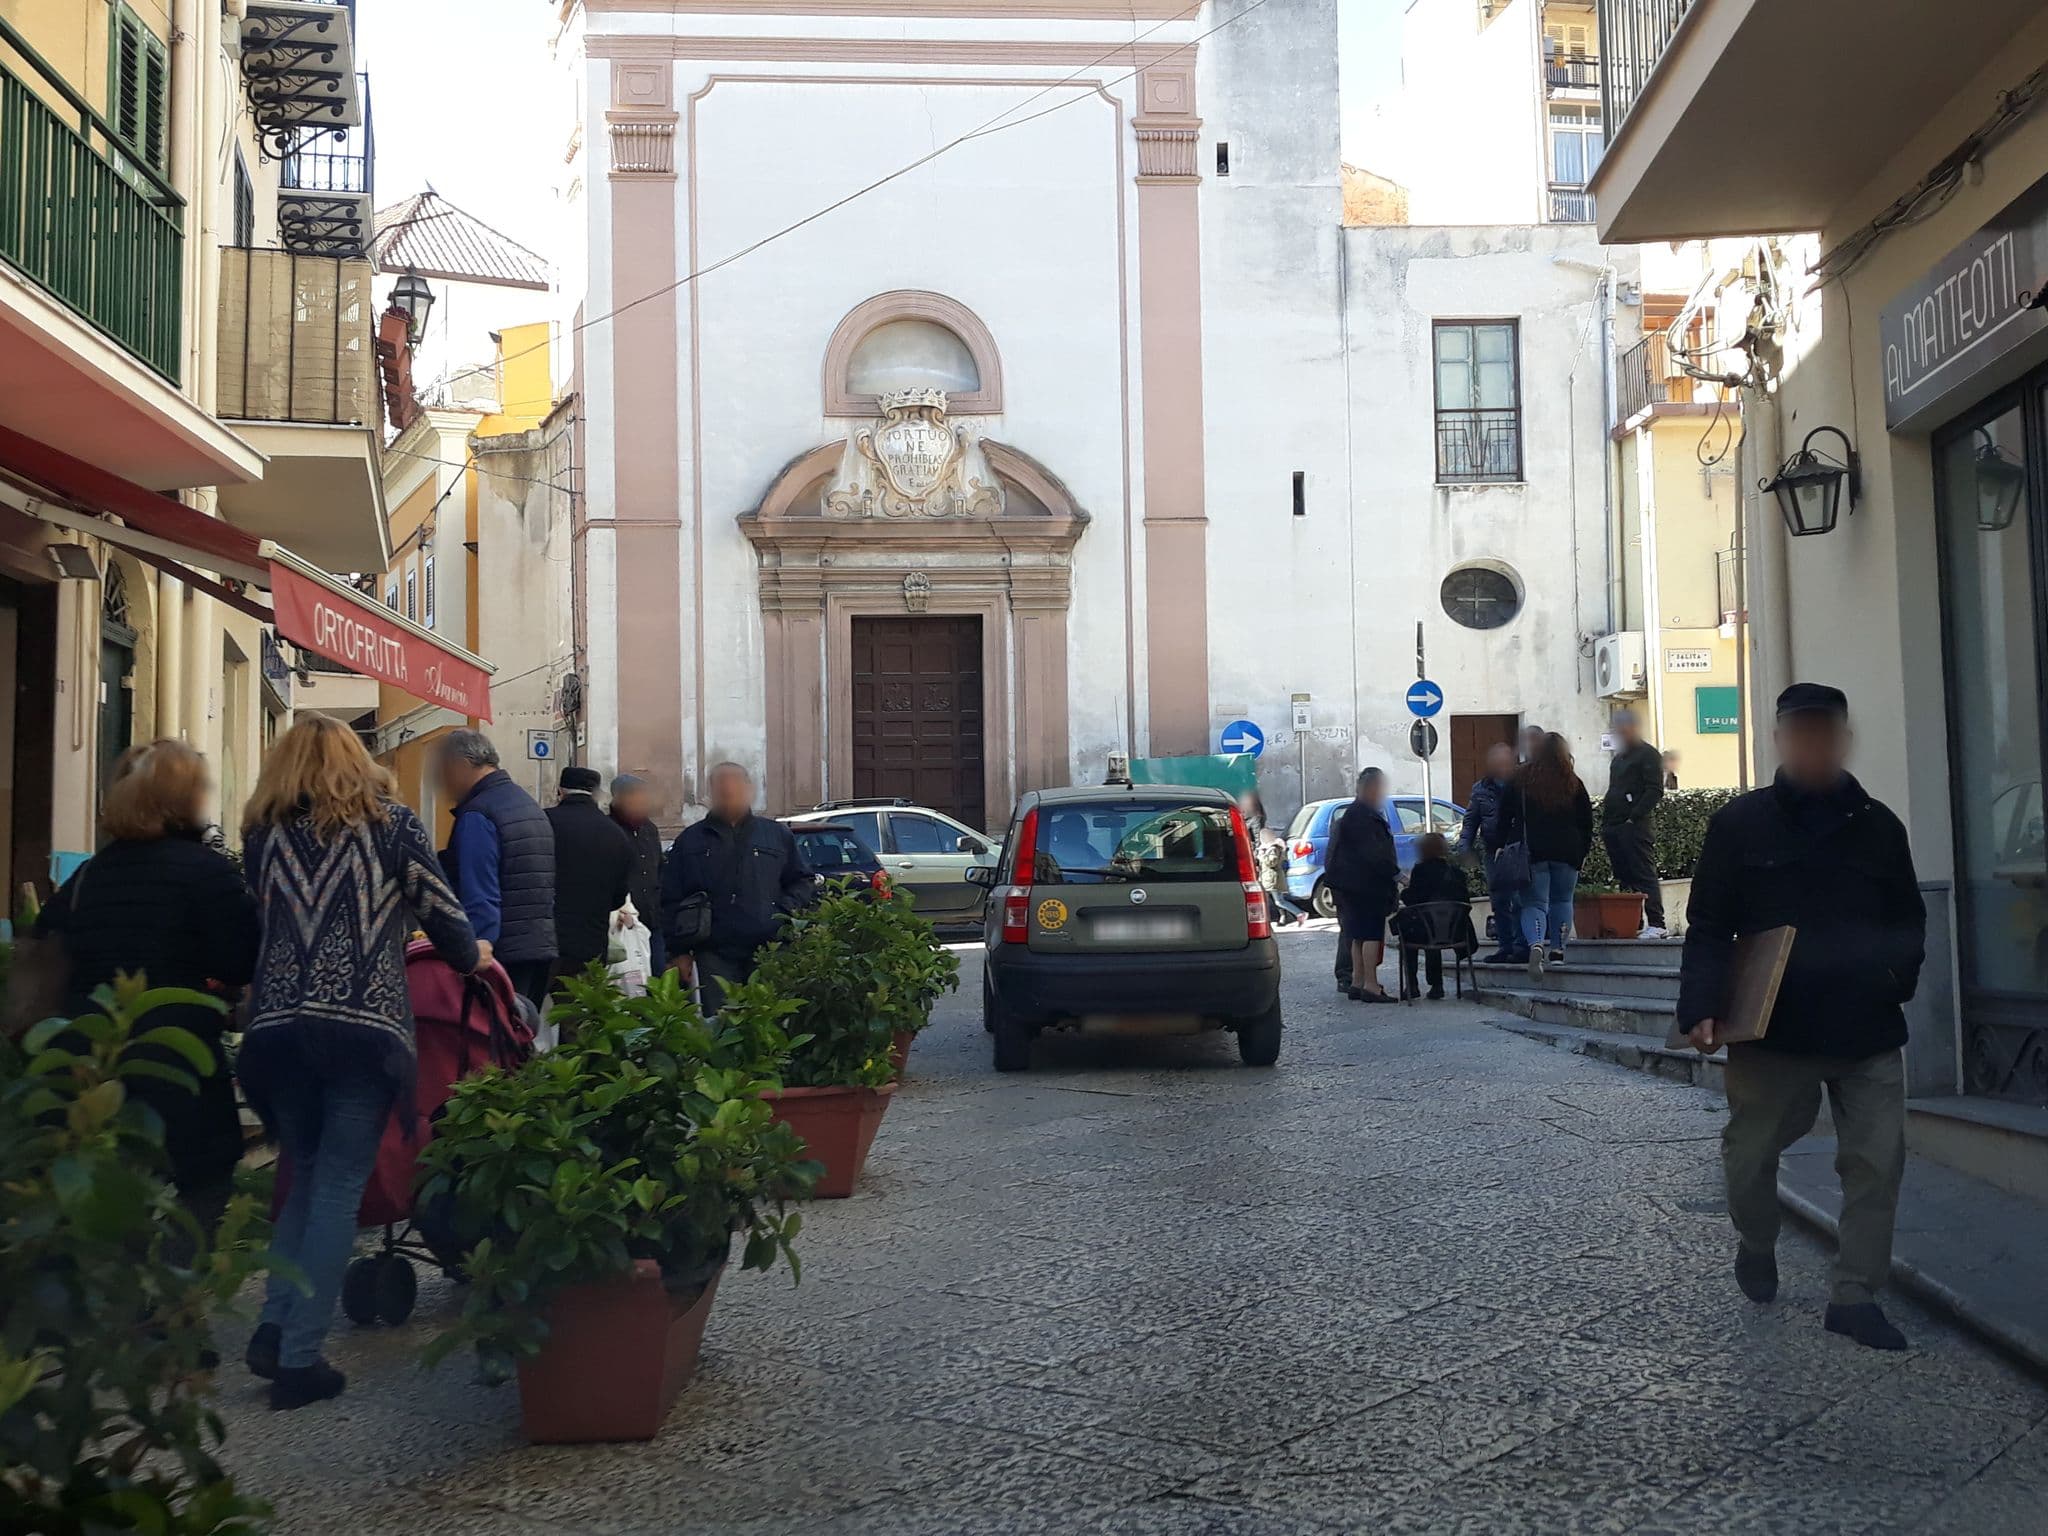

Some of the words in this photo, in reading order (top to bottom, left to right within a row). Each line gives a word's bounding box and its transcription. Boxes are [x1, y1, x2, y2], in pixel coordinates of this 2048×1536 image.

[1903, 231, 2018, 378] MATTEOTTI
[906, 441, 926, 452] NE
[313, 602, 409, 683] ORTOFRUTTA
[1704, 717, 1738, 725] THUN
